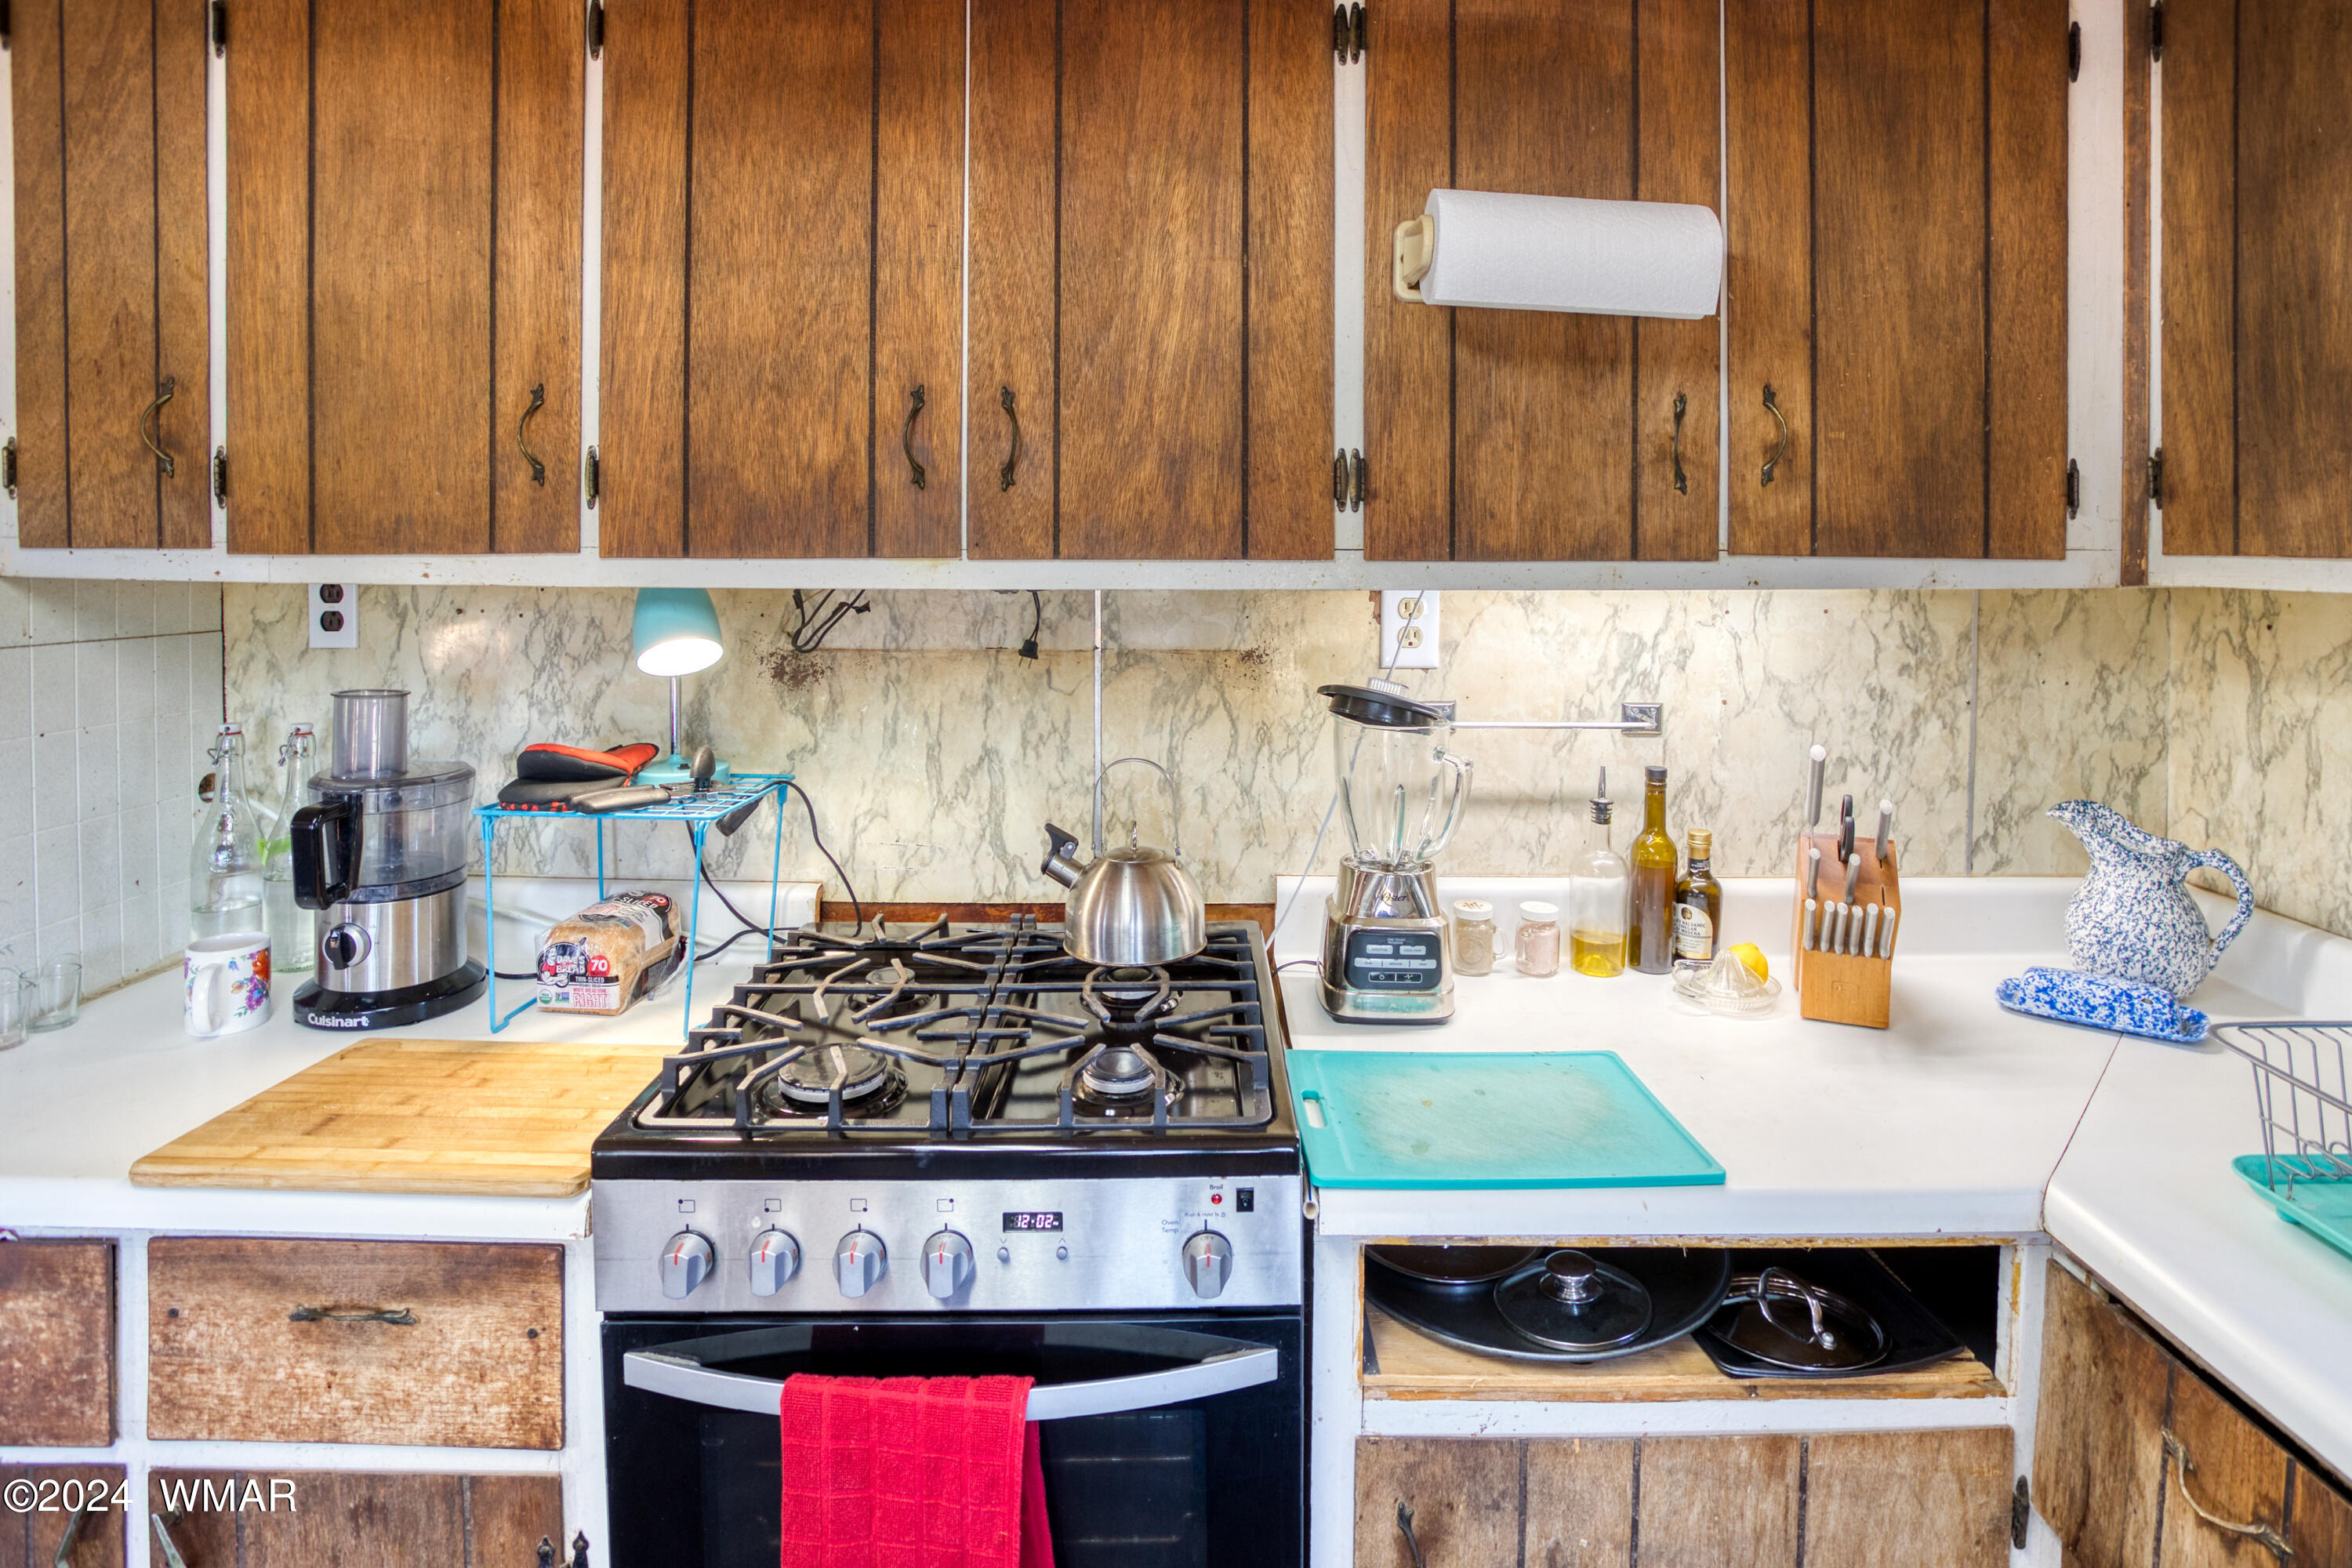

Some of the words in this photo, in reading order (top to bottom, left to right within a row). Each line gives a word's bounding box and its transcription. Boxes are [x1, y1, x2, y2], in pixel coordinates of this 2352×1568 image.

[556, 964, 586, 974] BREAD
[590, 959, 608, 972] 70
[572, 993, 608, 1008] RIGHT
[307, 1013, 369, 1028] Cuisinart
